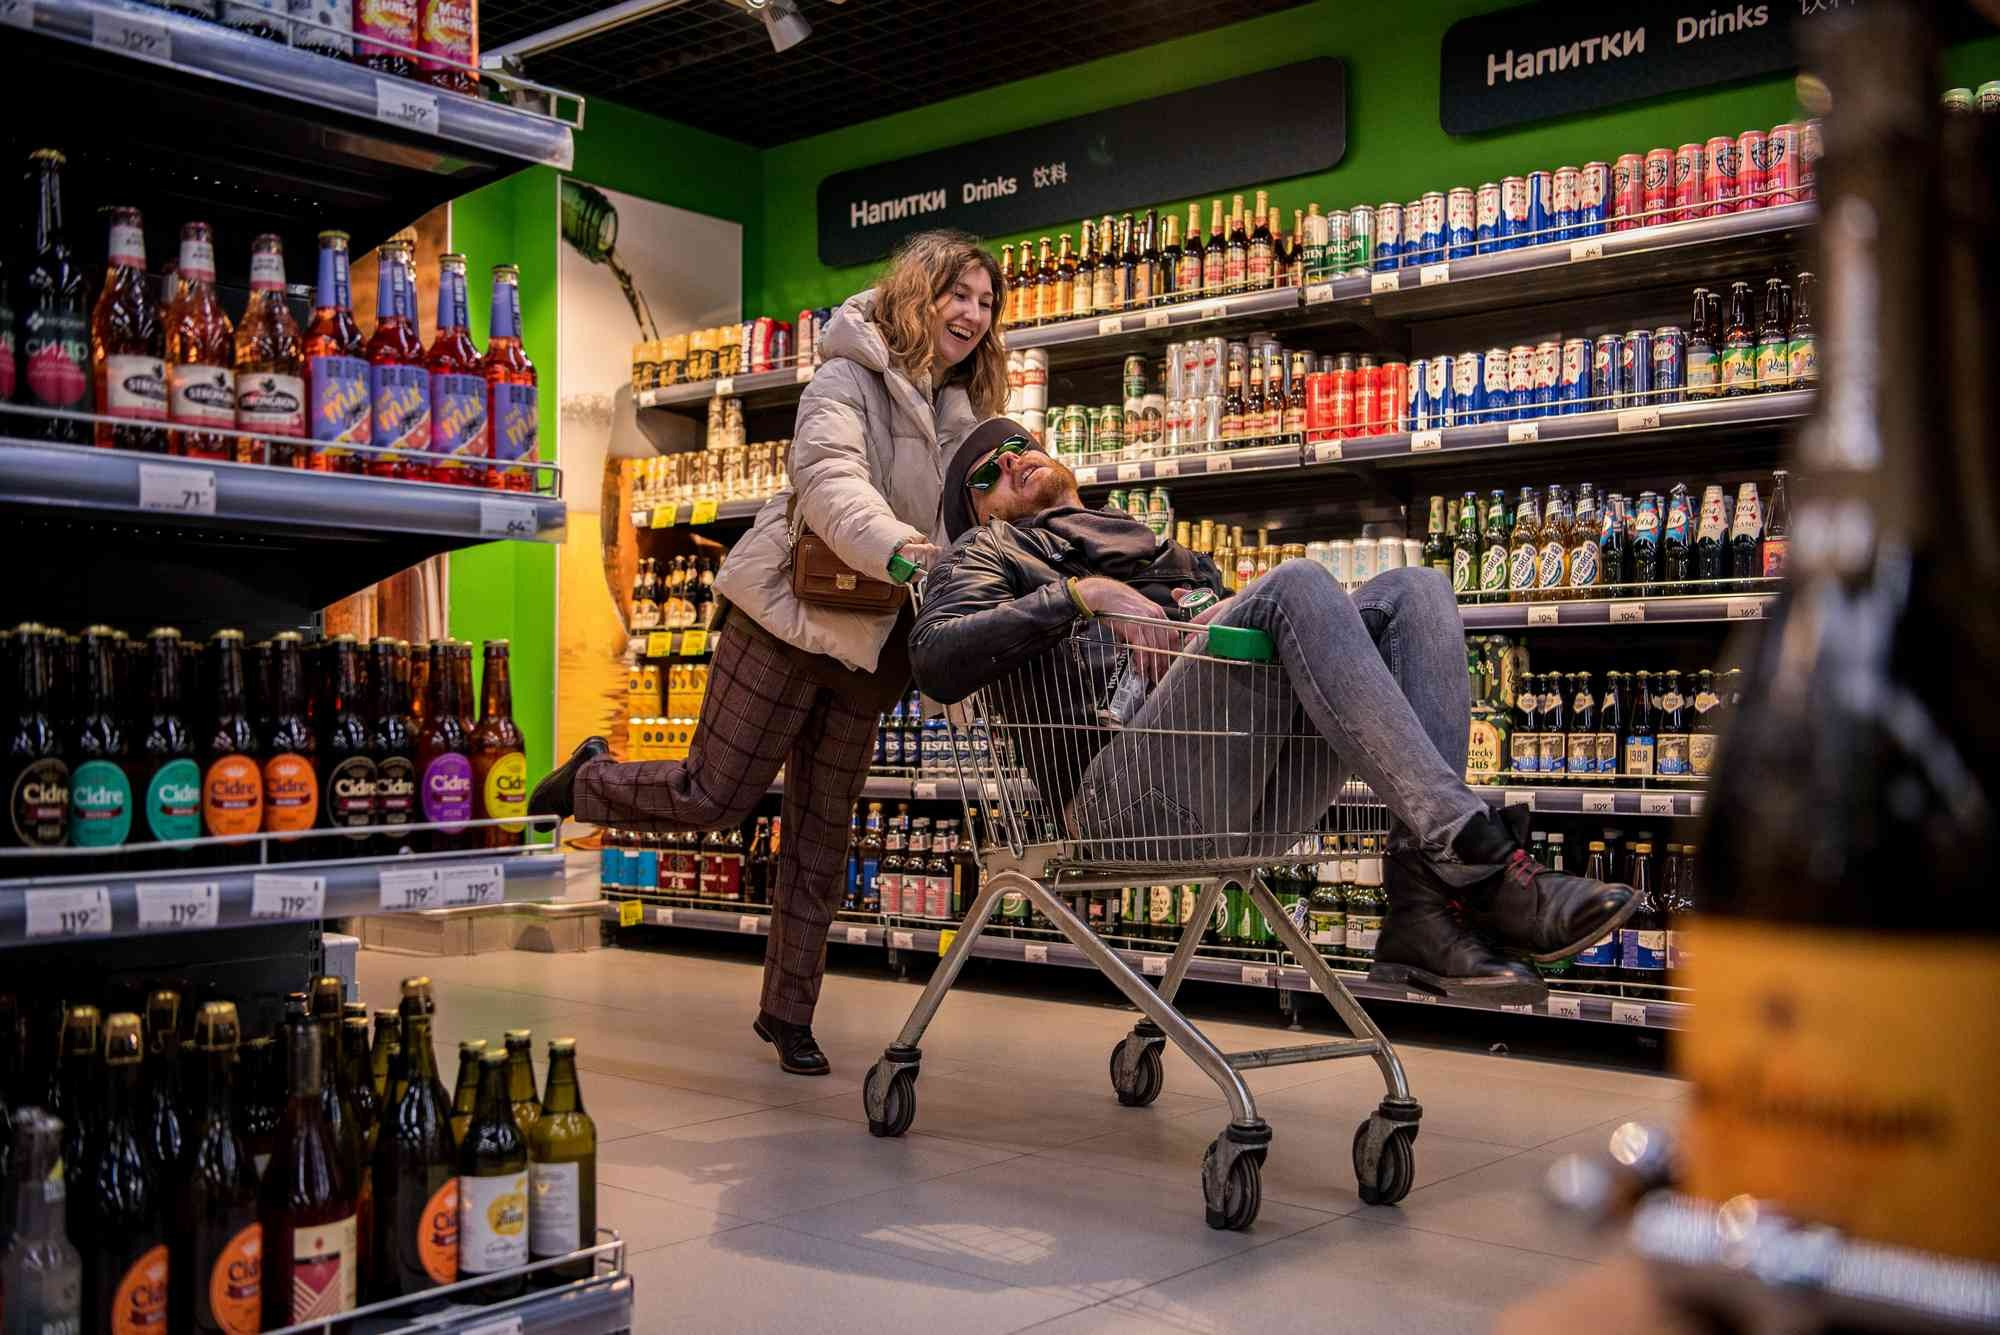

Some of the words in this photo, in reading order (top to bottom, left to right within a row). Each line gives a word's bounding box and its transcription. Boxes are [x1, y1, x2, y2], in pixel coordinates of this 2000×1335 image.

[1487, 27, 1646, 86] Напитки
[1676, 3, 1769, 44] Drinks
[851, 188, 947, 228] Напитки
[962, 176, 1018, 204] Drinks
[1033, 161, 1068, 189] 饮料
[1630, 750, 1648, 763] 1988
[211, 780, 256, 796] Cidre
[429, 774, 471, 791] Cidre
[73, 786, 125, 805] Cidre
[1593, 802, 1608, 810] 109
[405, 887, 429, 905] 119
[466, 882, 490, 901] 119
[168, 903, 199, 922] 119
[280, 896, 306, 914] 119
[59, 910, 90, 930] 119
